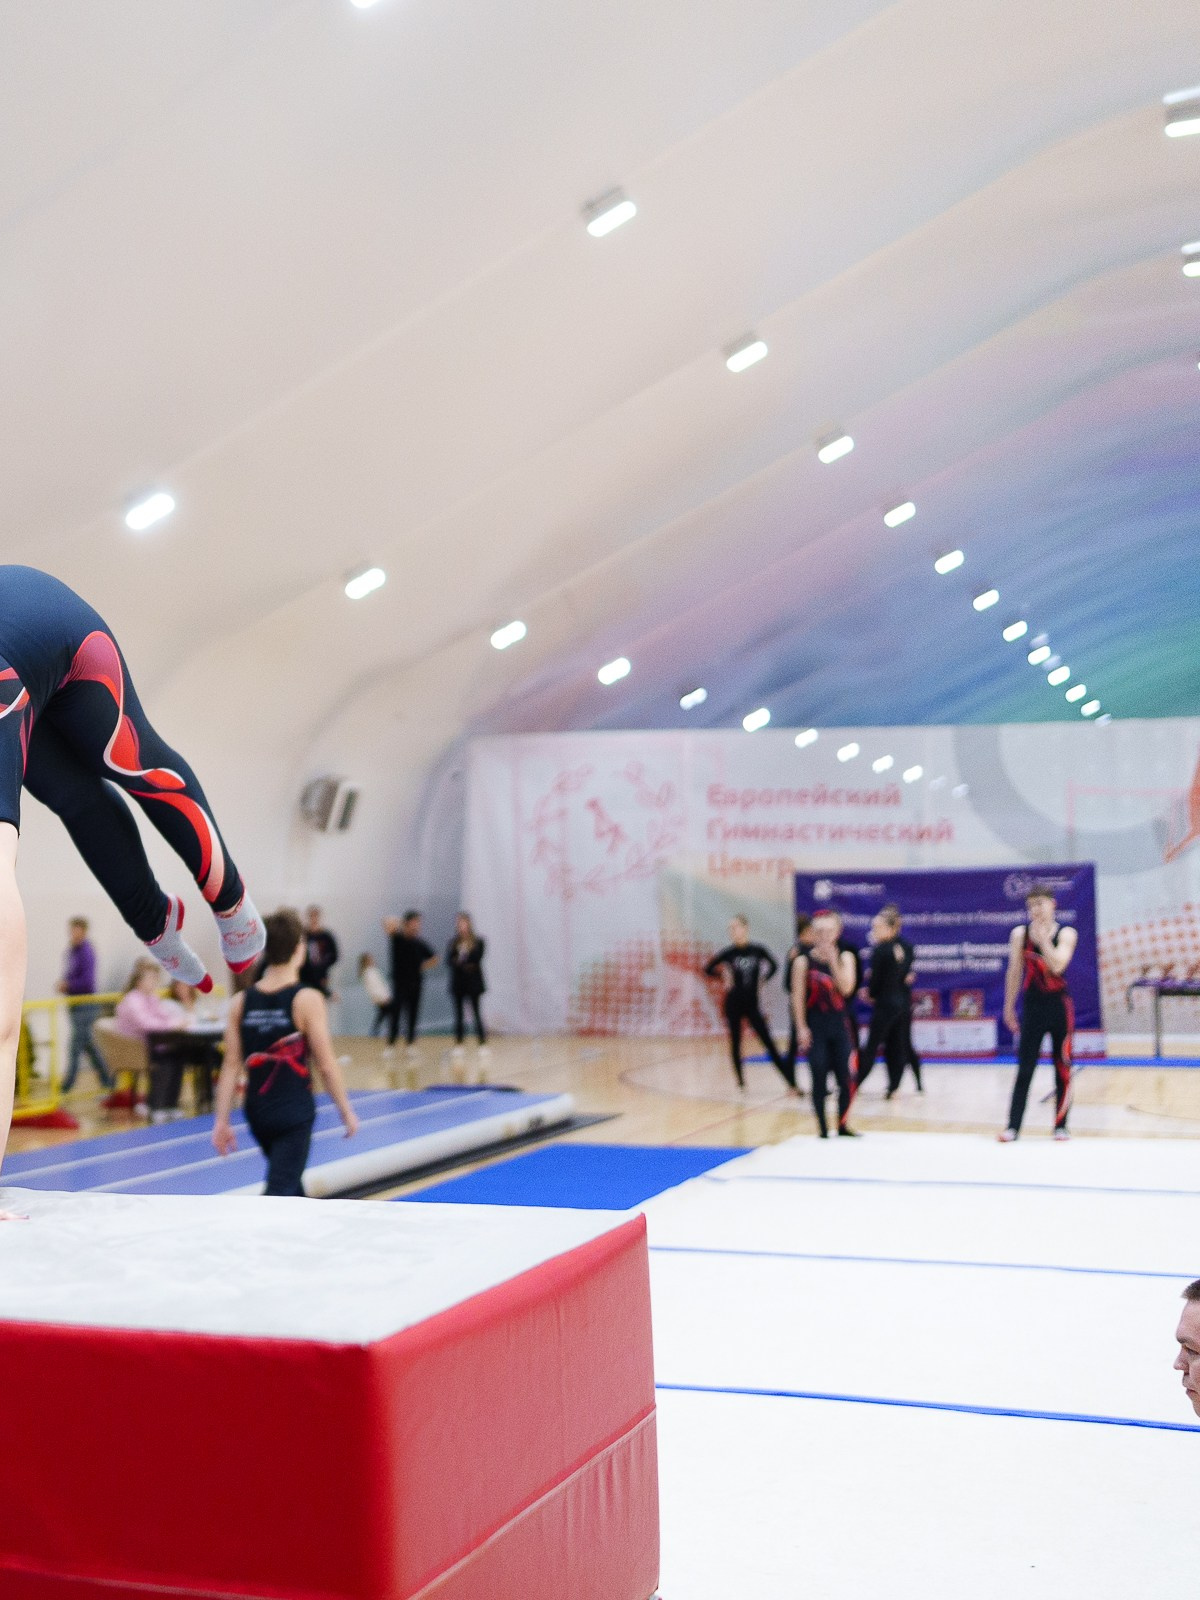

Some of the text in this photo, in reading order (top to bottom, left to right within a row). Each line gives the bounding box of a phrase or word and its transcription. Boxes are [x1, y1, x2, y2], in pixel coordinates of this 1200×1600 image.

[706, 781, 901, 810] Европейский
[706, 816, 955, 844] Гимнастический
[707, 852, 795, 878] Центр
